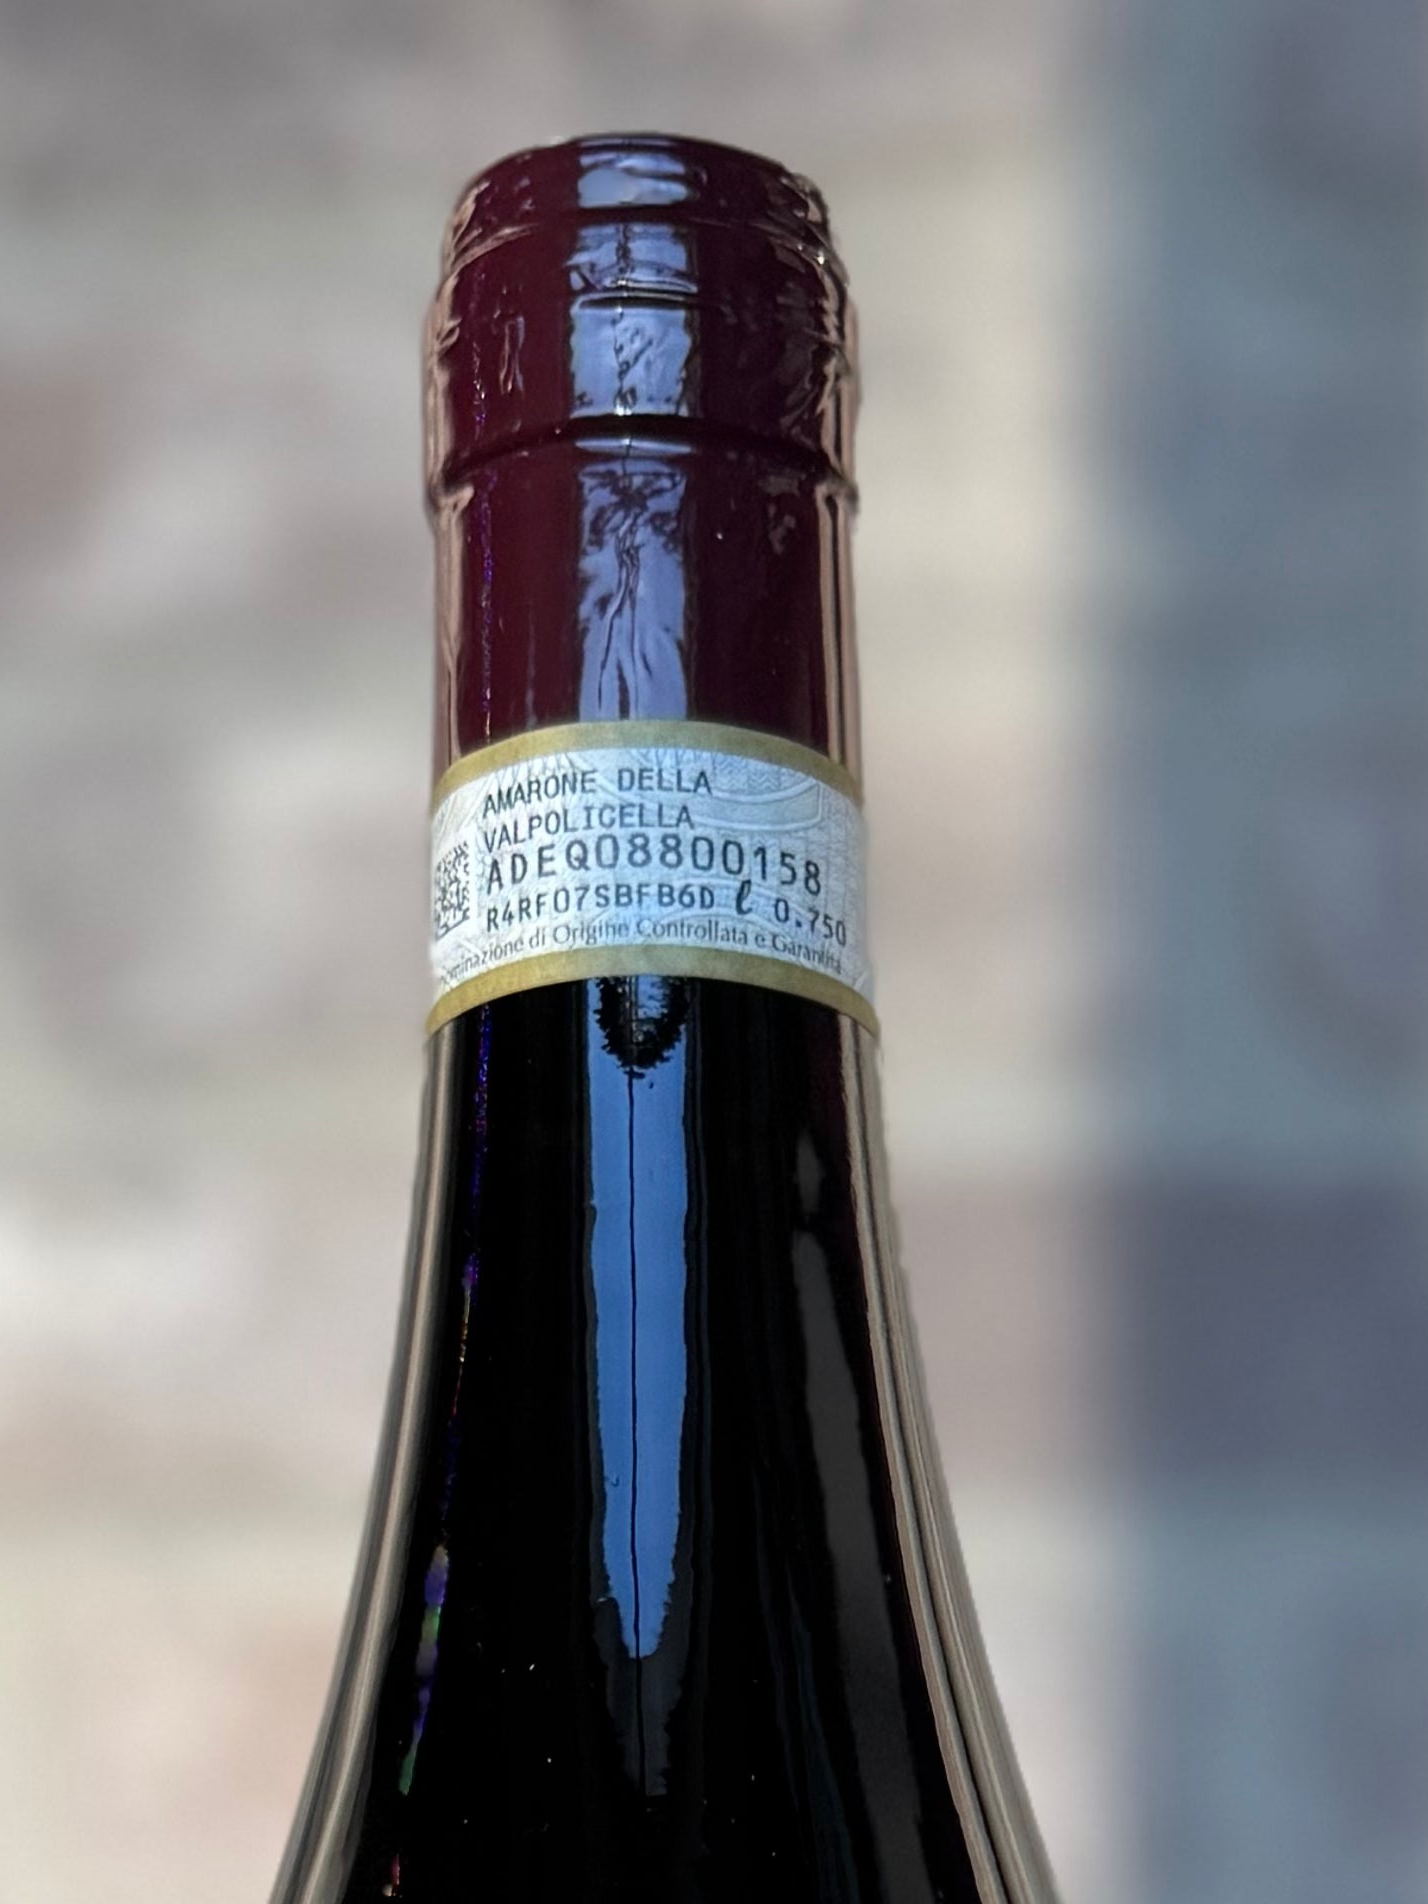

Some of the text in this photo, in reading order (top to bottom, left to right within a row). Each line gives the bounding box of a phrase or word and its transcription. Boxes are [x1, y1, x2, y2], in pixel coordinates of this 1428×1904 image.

[483, 769, 711, 818] AMARONE DELLA
[484, 803, 694, 852] VALPOLICELLA
[636, 918, 748, 945] Controllata
[775, 898, 846, 947] 0.750
